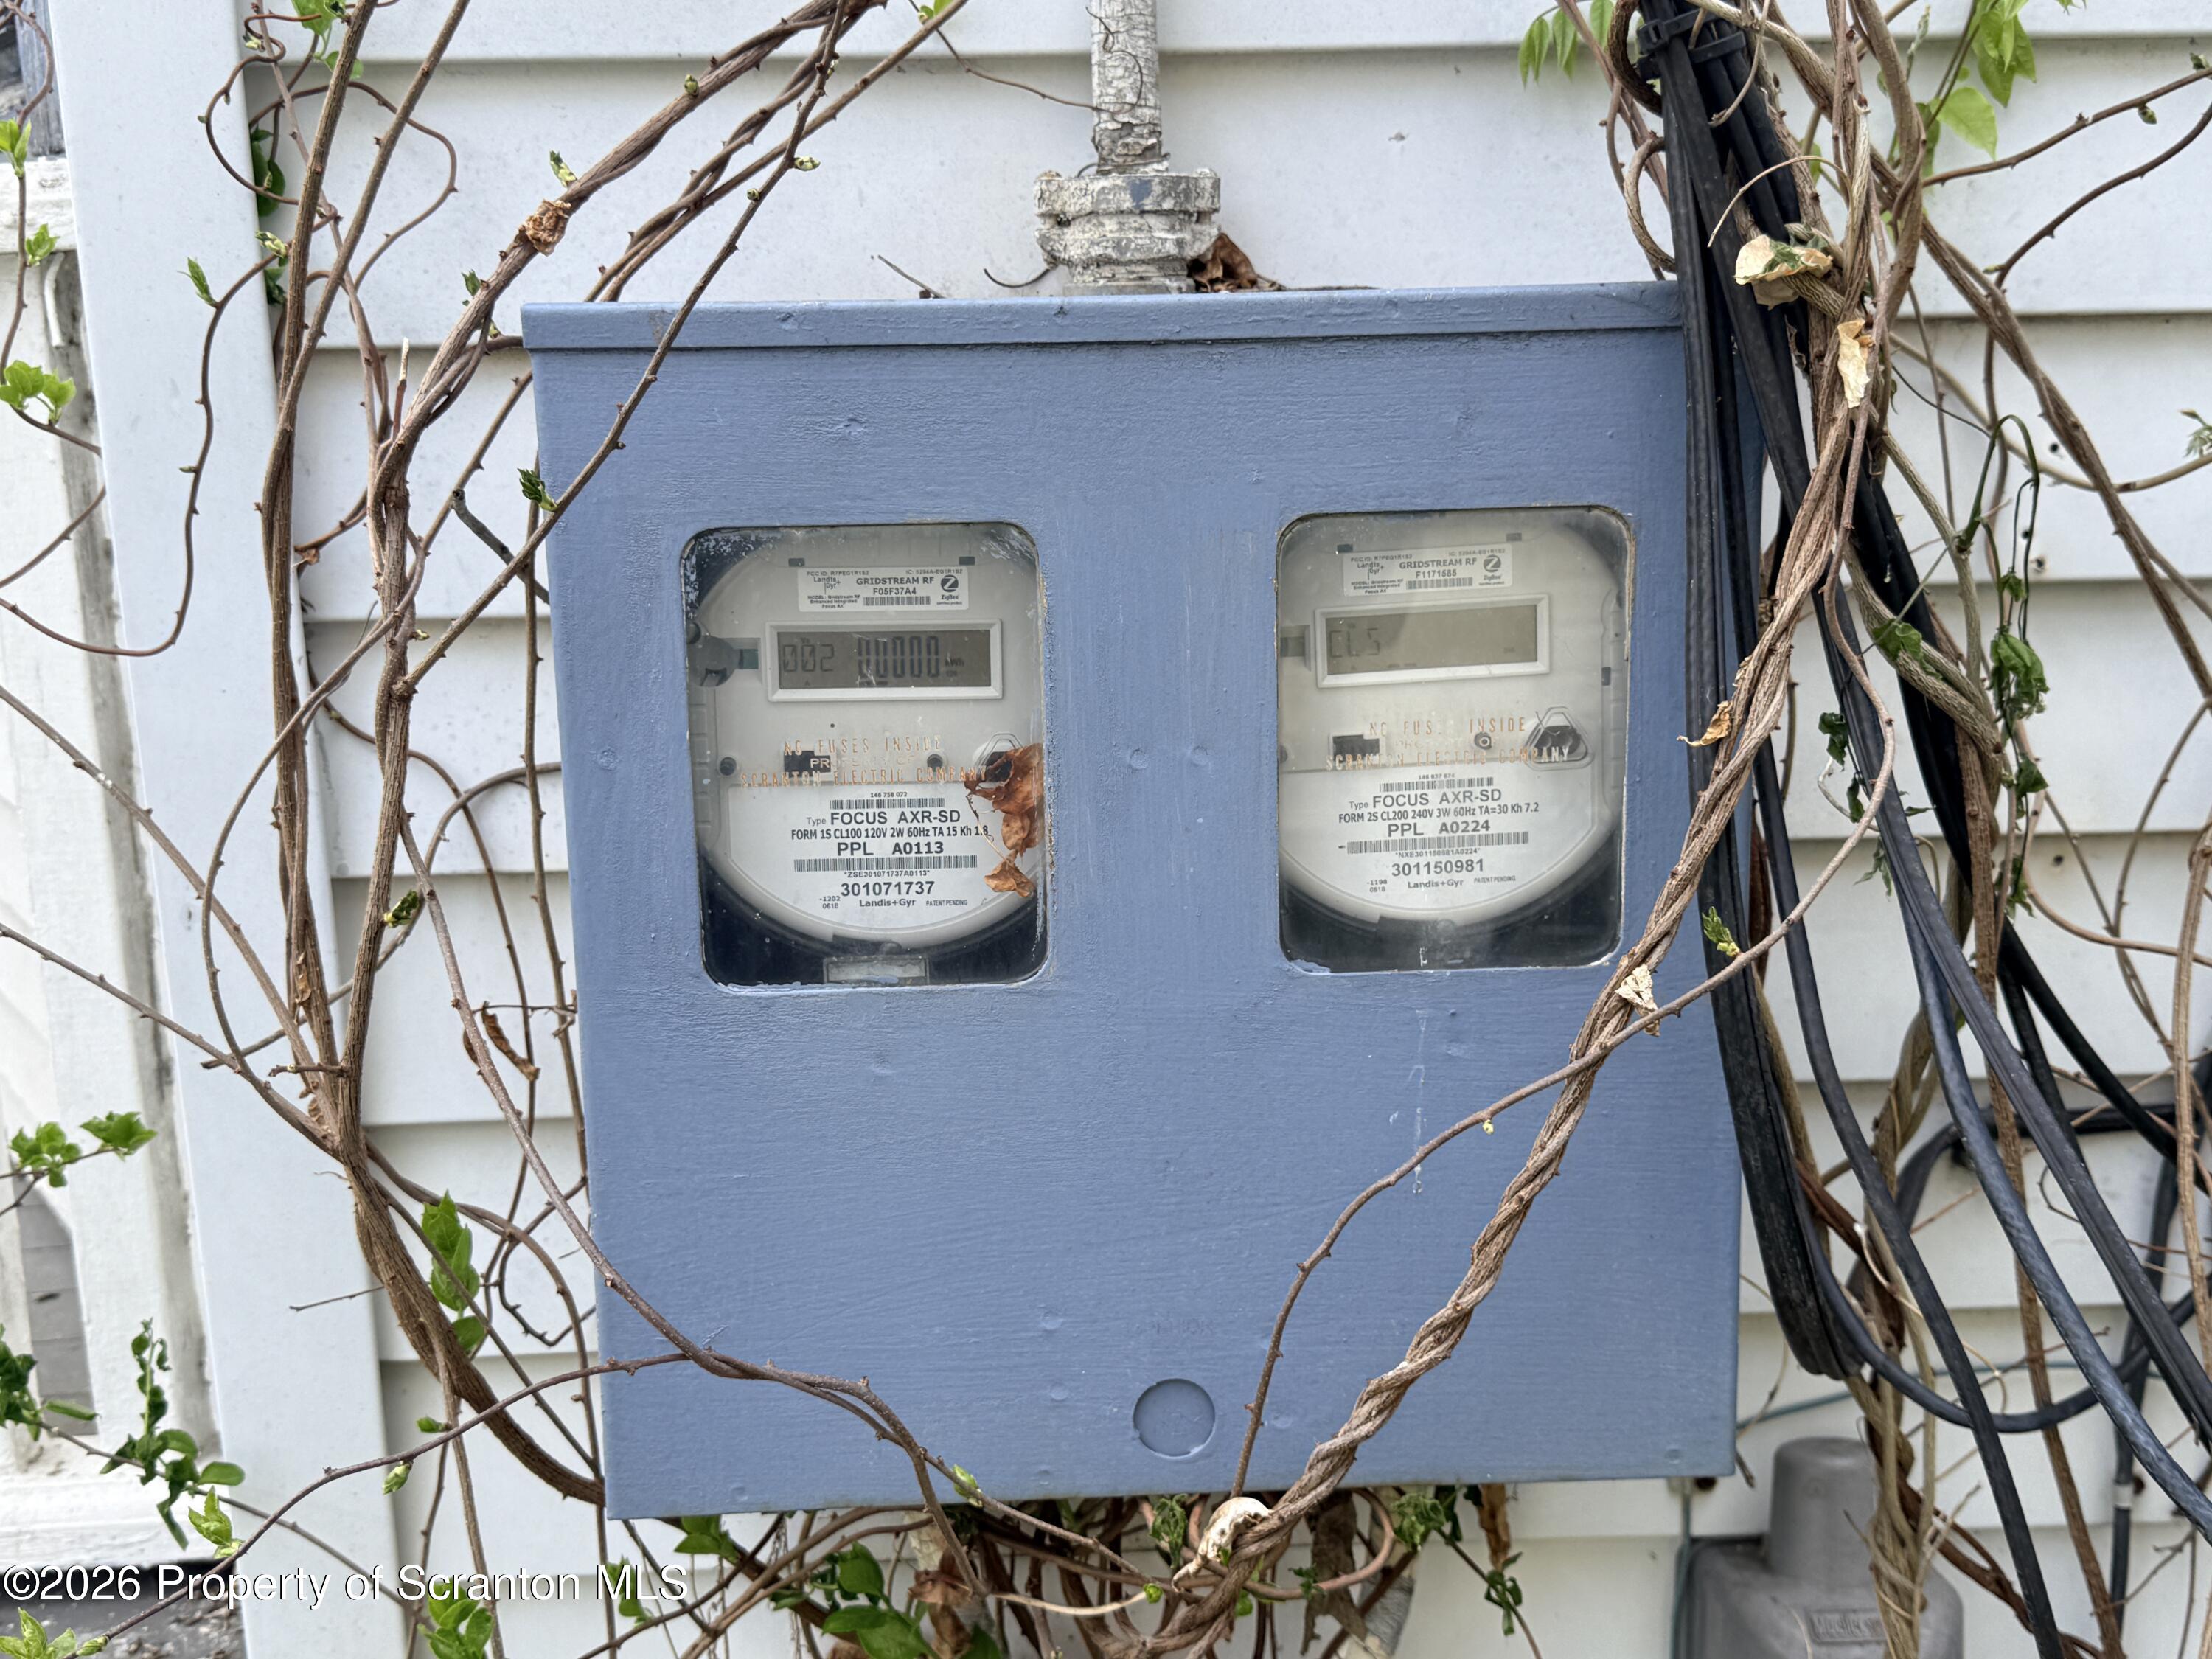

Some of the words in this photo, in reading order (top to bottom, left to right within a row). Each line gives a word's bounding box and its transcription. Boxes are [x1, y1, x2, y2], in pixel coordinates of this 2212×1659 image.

[1399, 560, 1463, 569] GRIDSTREAM
[856, 577, 920, 585] GRIDSTREAM
[922, 576, 935, 584] RF
[873, 587, 917, 596] F05F37A4
[782, 644, 835, 672] 002
[1470, 717, 1526, 733] INSIDE
[818, 738, 869, 754] FUSES
[885, 735, 941, 751] INSIDE
[1498, 746, 1569, 764] COMPANY
[742, 771, 821, 788] SCRANTON
[834, 768, 904, 785] ELECTRIC
[916, 766, 987, 783] COMPANY
[1349, 801, 1368, 810] Type
[1372, 793, 1429, 808] FOCUS
[1439, 789, 1502, 805] AXR-SD
[807, 817, 827, 827] Type
[830, 811, 888, 826] FOCUS
[897, 810, 961, 824] AXR-SD
[1338, 813, 1365, 824] FORM
[1368, 812, 1378, 821] 2S
[1380, 810, 1408, 821] CL200
[1411, 809, 1434, 819] 240V
[1436, 808, 1450, 818] 3W
[1453, 807, 1476, 816] 60Hz
[1478, 805, 1508, 815] TA=30
[1510, 804, 1523, 813] Kh
[1524, 802, 1539, 813] 7.2
[791, 829, 817, 840] FORM
[821, 829, 832, 839] 1S
[834, 828, 862, 839] CL100
[865, 827, 888, 838] 120V
[890, 827, 905, 838] 2W
[907, 827, 931, 838] 60Hz
[932, 827, 943, 837] TA
[947, 826, 958, 837] 15
[960, 826, 972, 836] Kh
[1388, 823, 1424, 838] PPL
[1438, 820, 1491, 835] A0224
[837, 842, 874, 856] PPL
[891, 841, 945, 855] A0113
[1391, 858, 1485, 877] 301150981
[841, 881, 935, 897] 301071737
[1408, 879, 1464, 889] Landis+Gyr
[859, 899, 917, 908] Landis+Gyr
